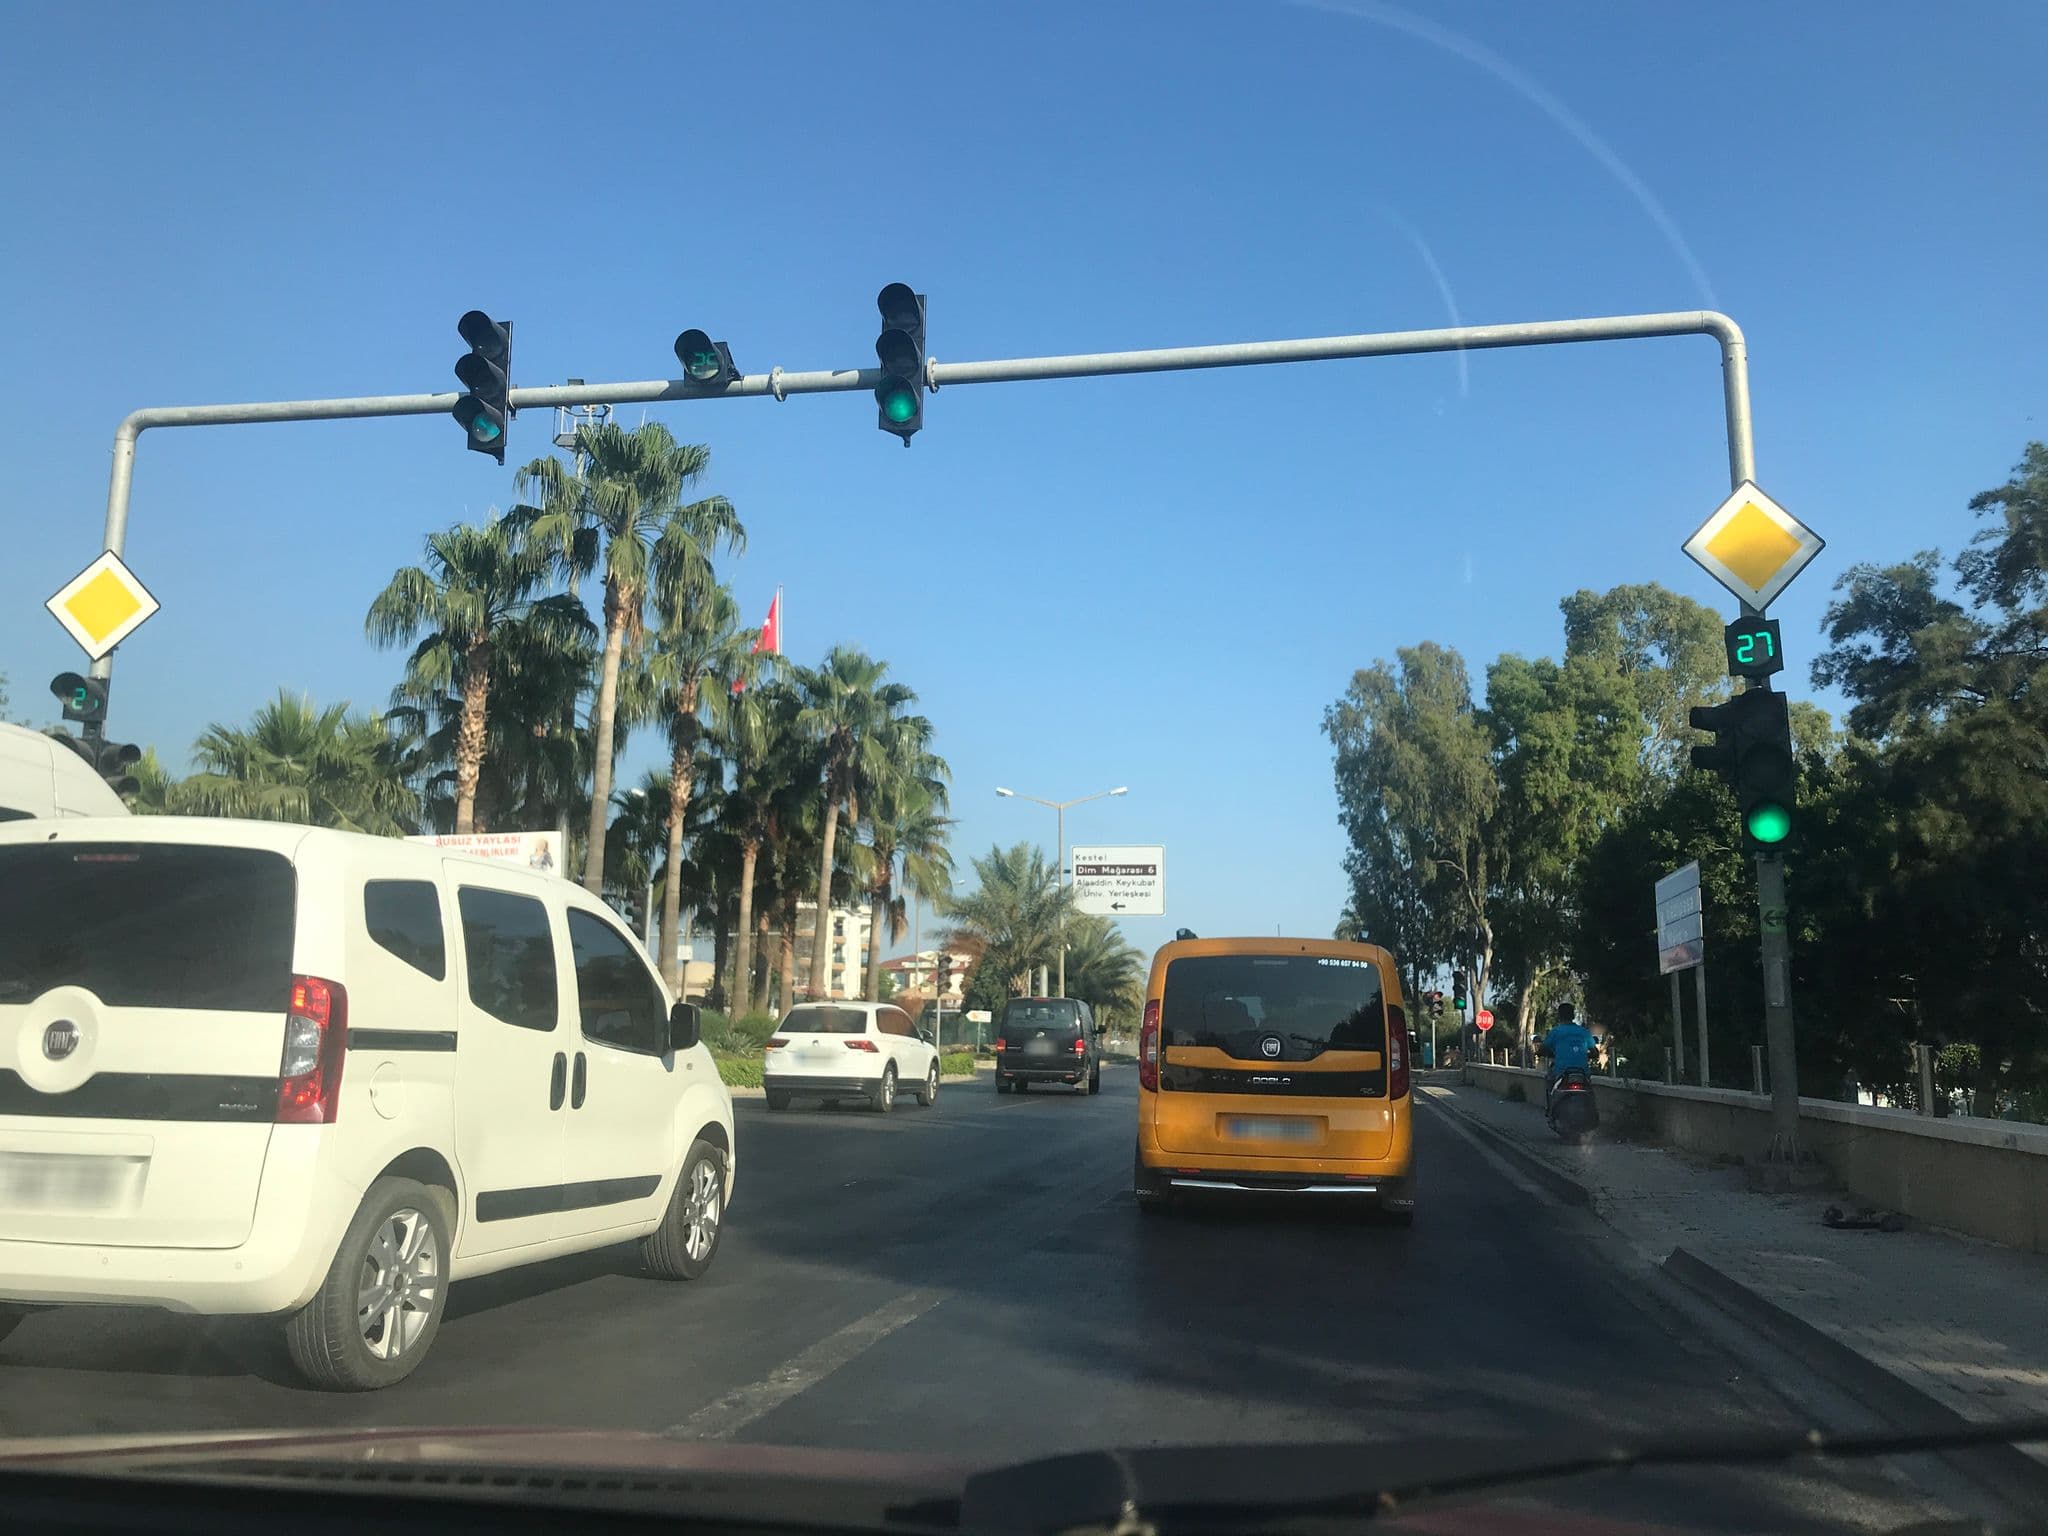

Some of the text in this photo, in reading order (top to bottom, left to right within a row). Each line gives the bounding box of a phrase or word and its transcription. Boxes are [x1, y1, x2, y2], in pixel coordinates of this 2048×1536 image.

[1736, 631, 1774, 663] 27
[476, 835, 521, 845] YAYLASI
[1075, 854, 1108, 862] Kestel
[1077, 865, 1155, 876] Dim Mağarası 6
[1076, 878, 1156, 888] Alaaddin Keykubat
[1108, 889, 1152, 898] Yerleşkesi
